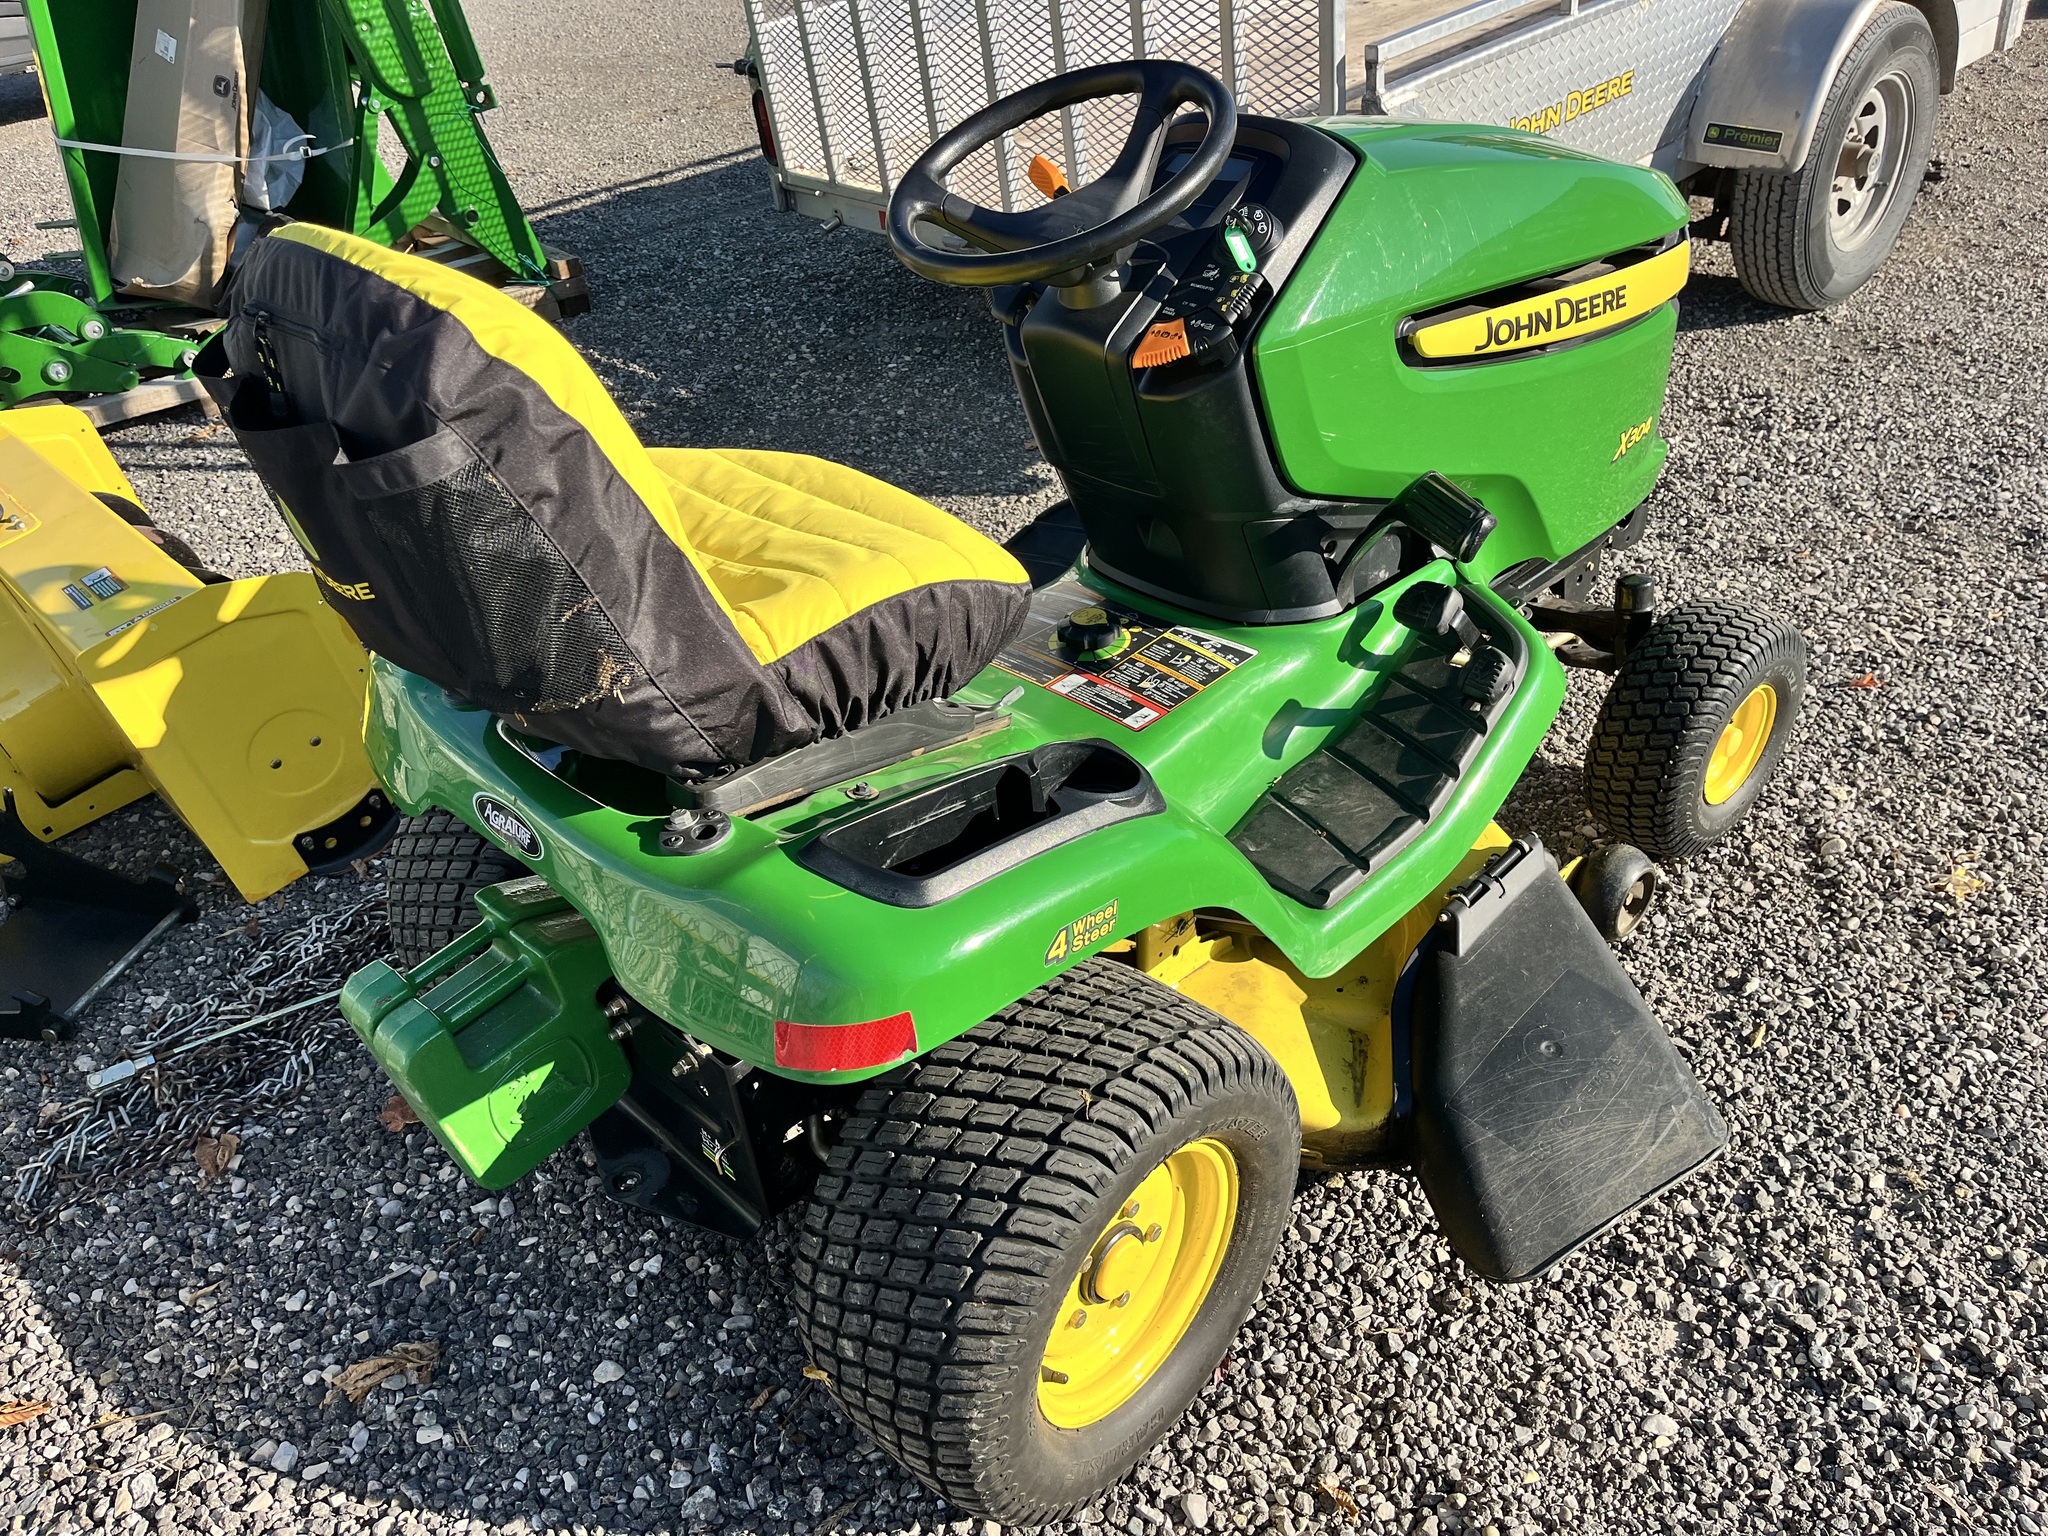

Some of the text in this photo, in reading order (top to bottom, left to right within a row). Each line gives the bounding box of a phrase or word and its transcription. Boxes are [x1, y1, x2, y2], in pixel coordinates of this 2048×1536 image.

[1565, 69, 1634, 122] DEERE
[1724, 128, 1779, 146] Premier
[1474, 285, 1627, 352] JOHN DEERE
[1611, 415, 1653, 464] X304
[484, 803, 531, 847] AGRATURF
[1071, 898, 1118, 937] Wheel
[1071, 917, 1117, 953] Steer
[1045, 927, 1069, 965] 4
